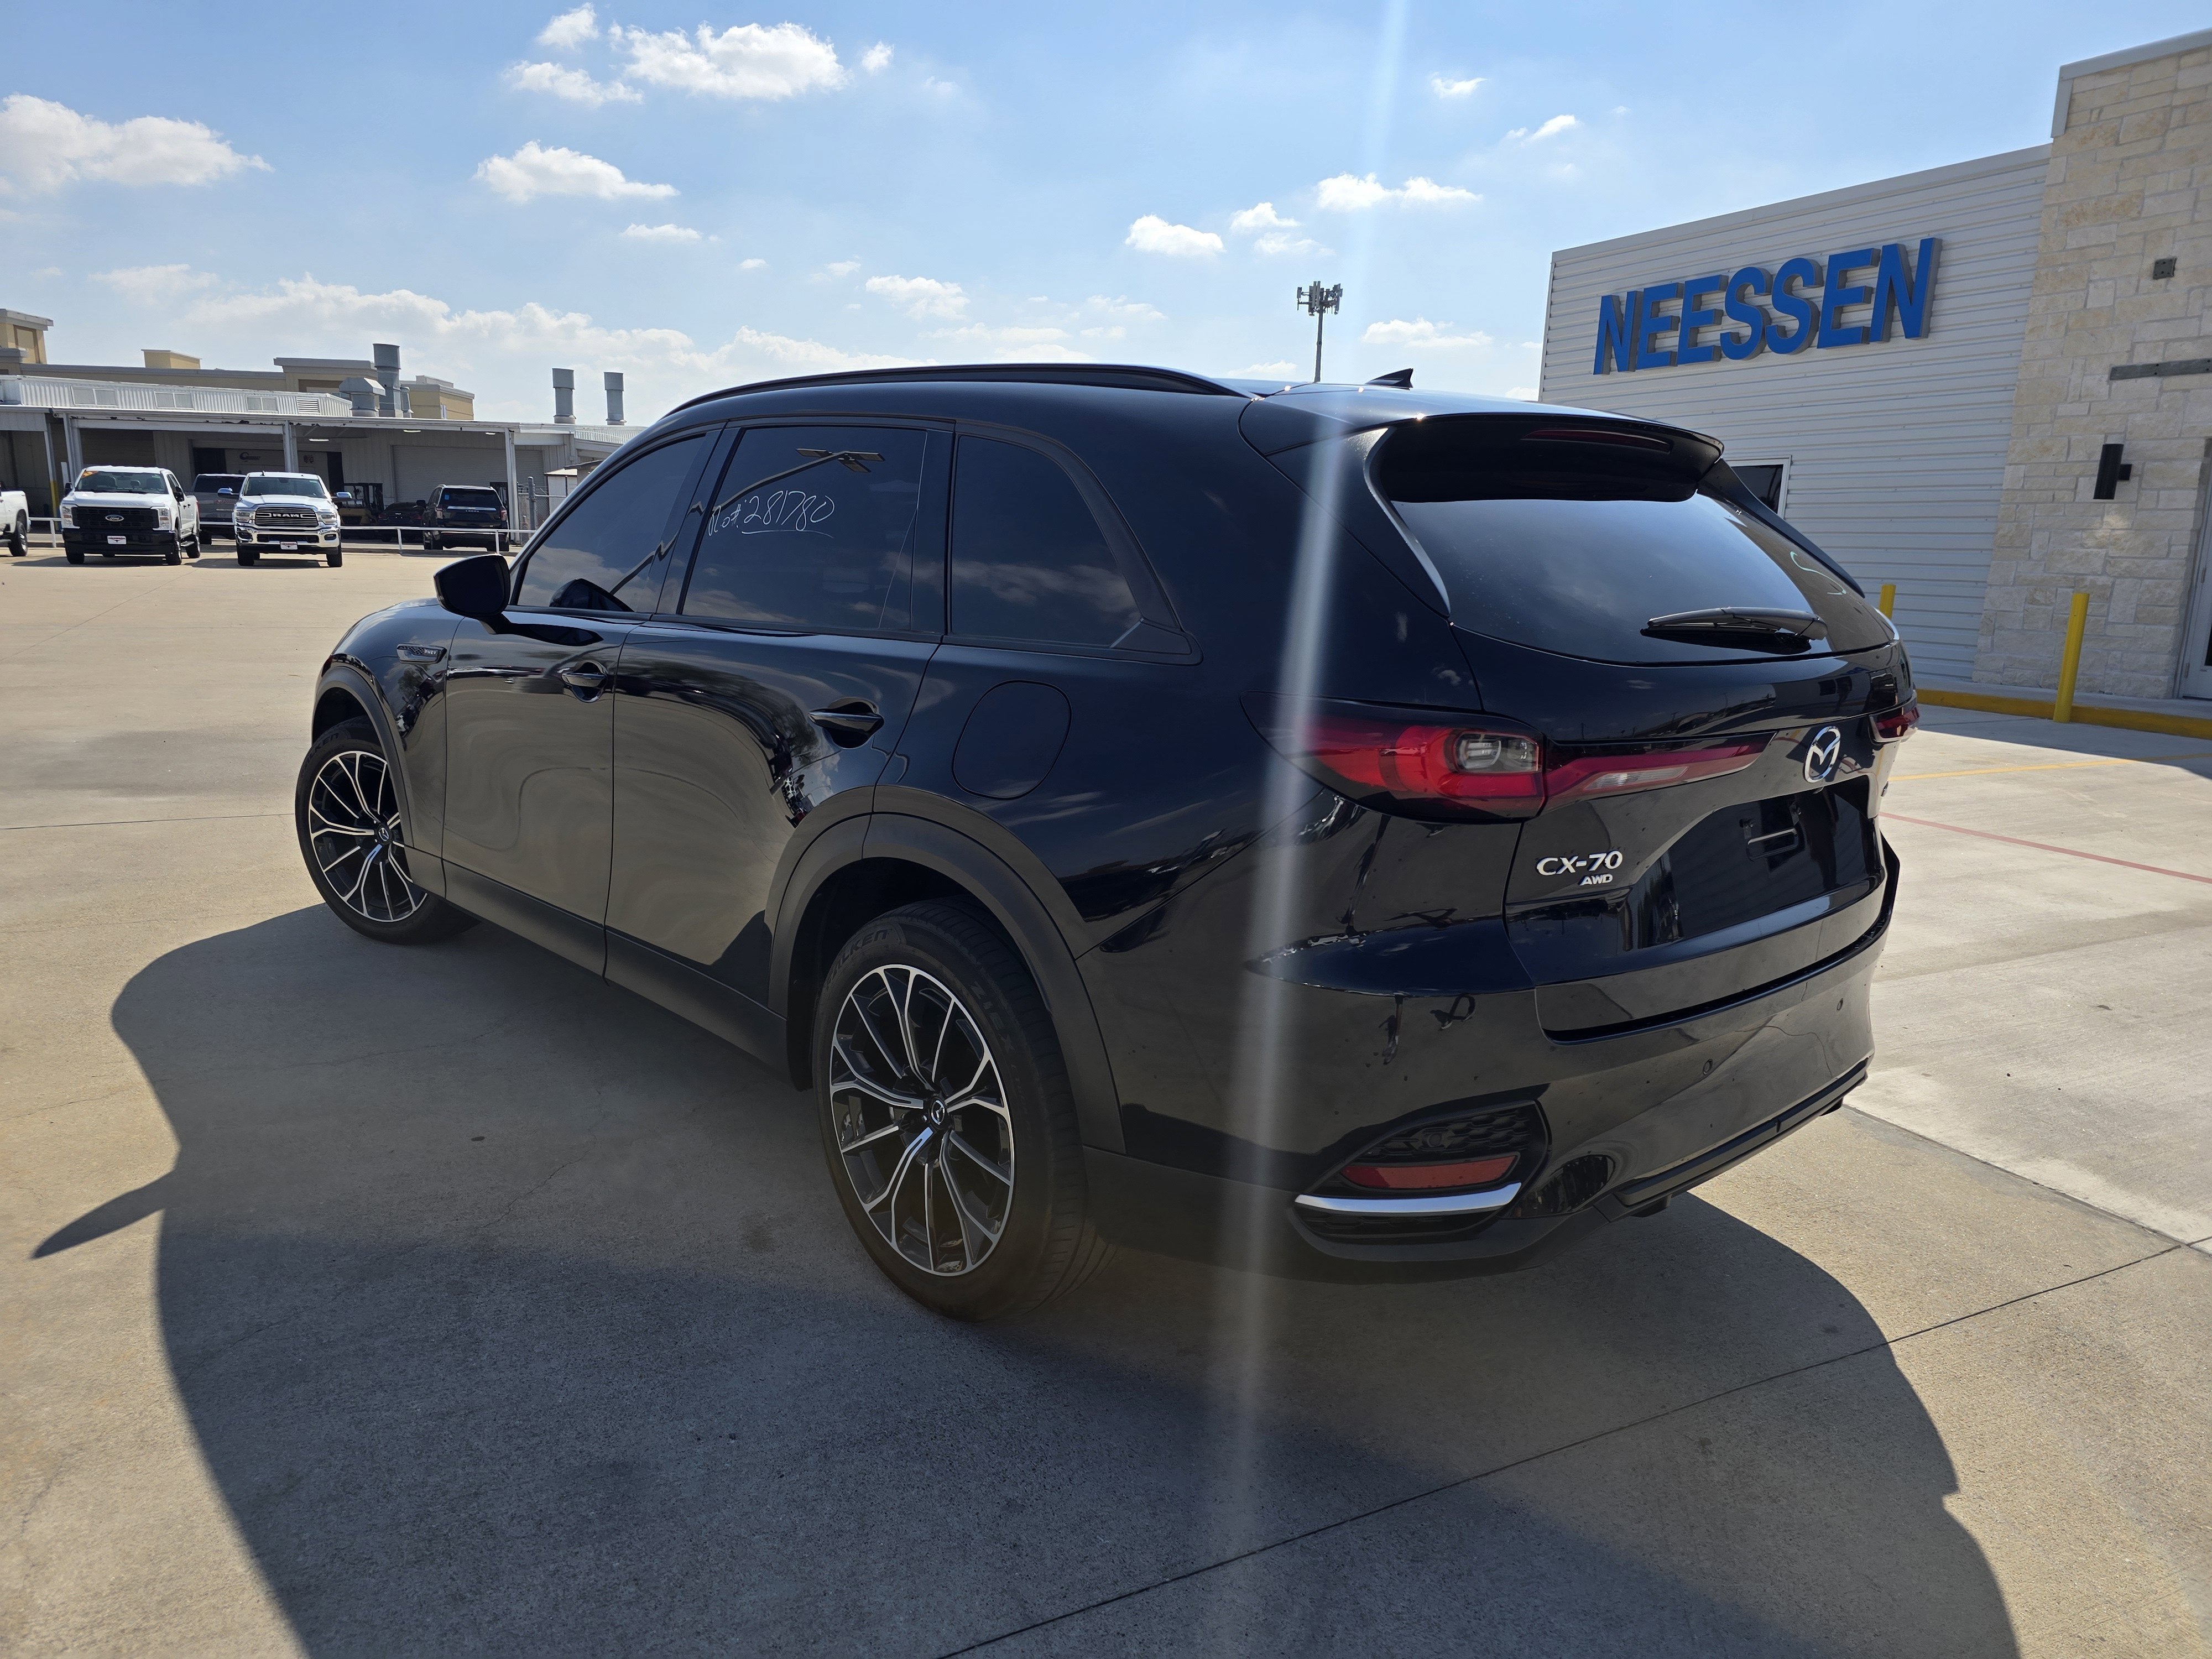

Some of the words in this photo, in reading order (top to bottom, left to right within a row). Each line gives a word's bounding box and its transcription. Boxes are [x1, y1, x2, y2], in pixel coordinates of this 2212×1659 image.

[1593, 237, 1943, 375] NEESSEN
[1536, 850, 1623, 875] CX-70
[1579, 873, 1613, 886] AWD
